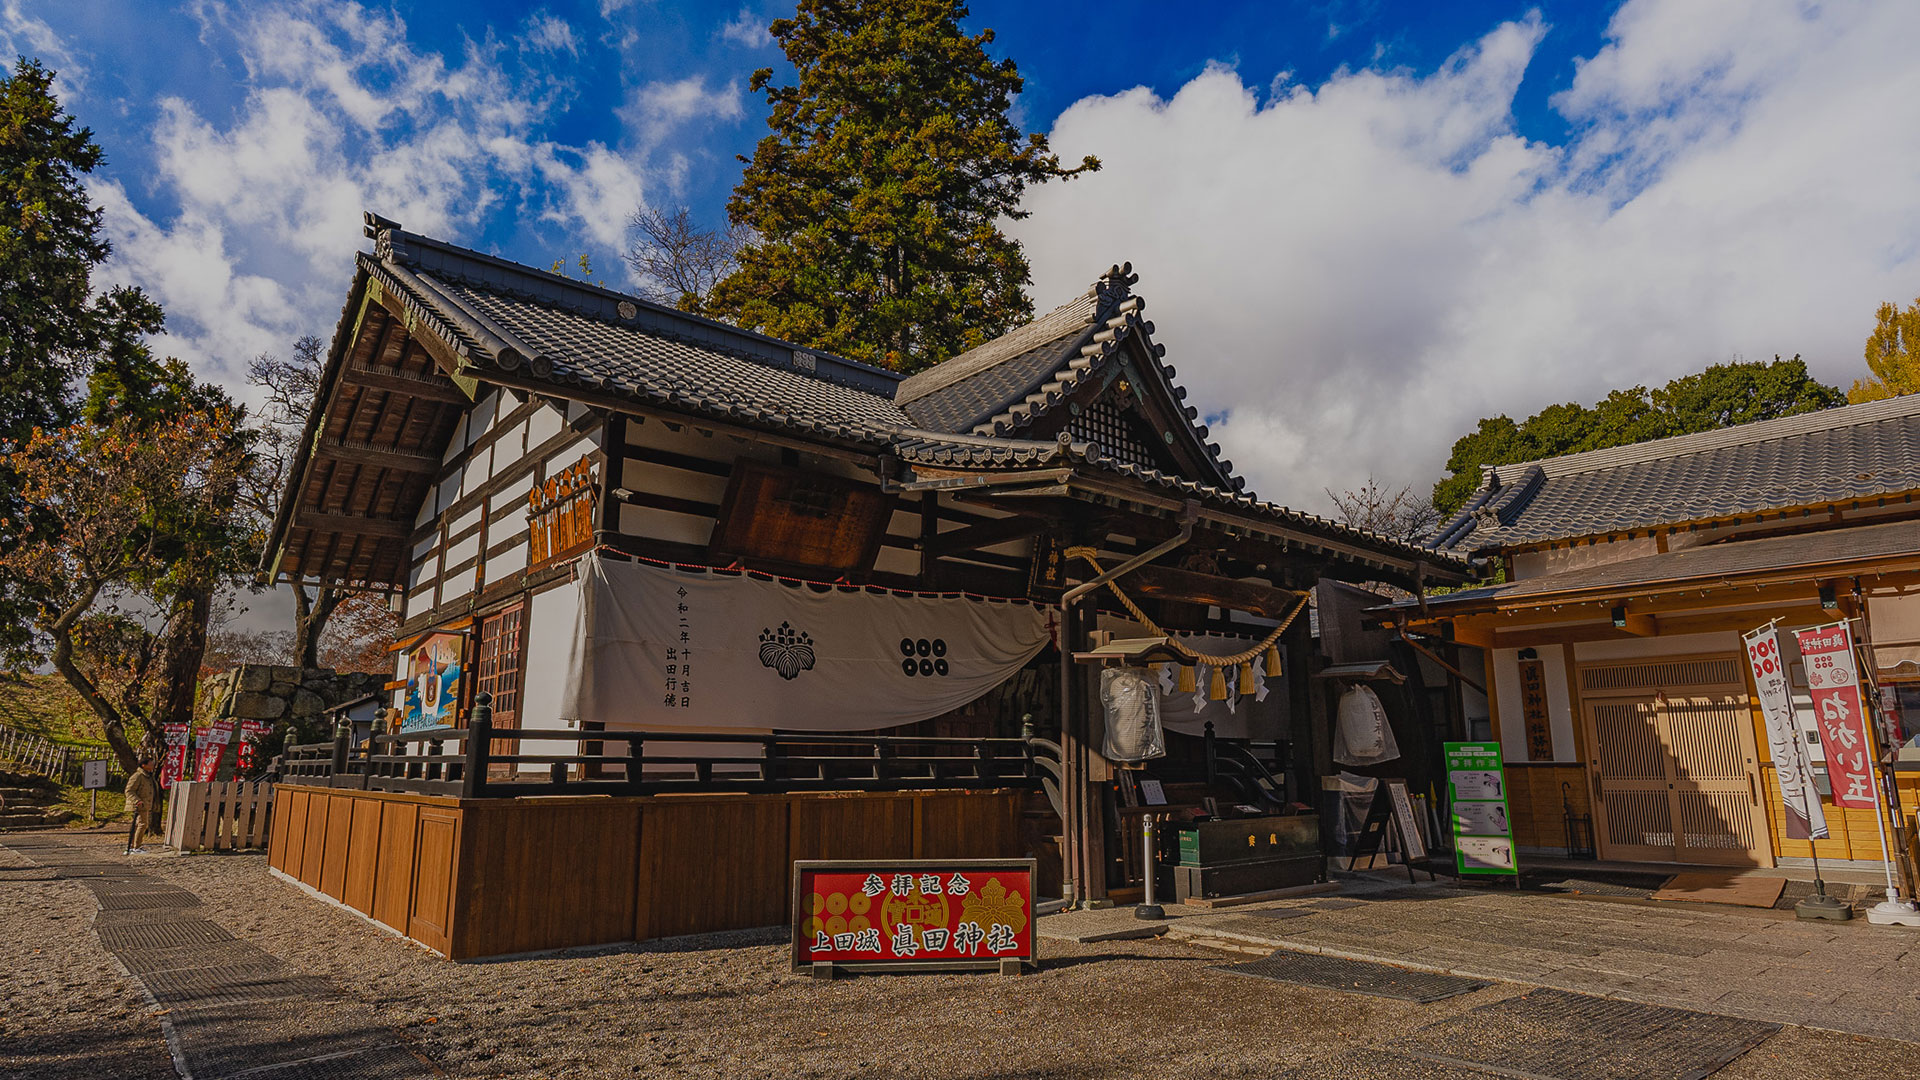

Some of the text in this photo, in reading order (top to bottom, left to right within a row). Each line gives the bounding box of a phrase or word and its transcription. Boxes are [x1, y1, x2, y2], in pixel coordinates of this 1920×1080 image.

[677, 586, 691, 708] 令和二年十月吉日
[862, 872, 970, 896] 参拝記念
[810, 922, 1018, 957] 上田城 眞田神社
